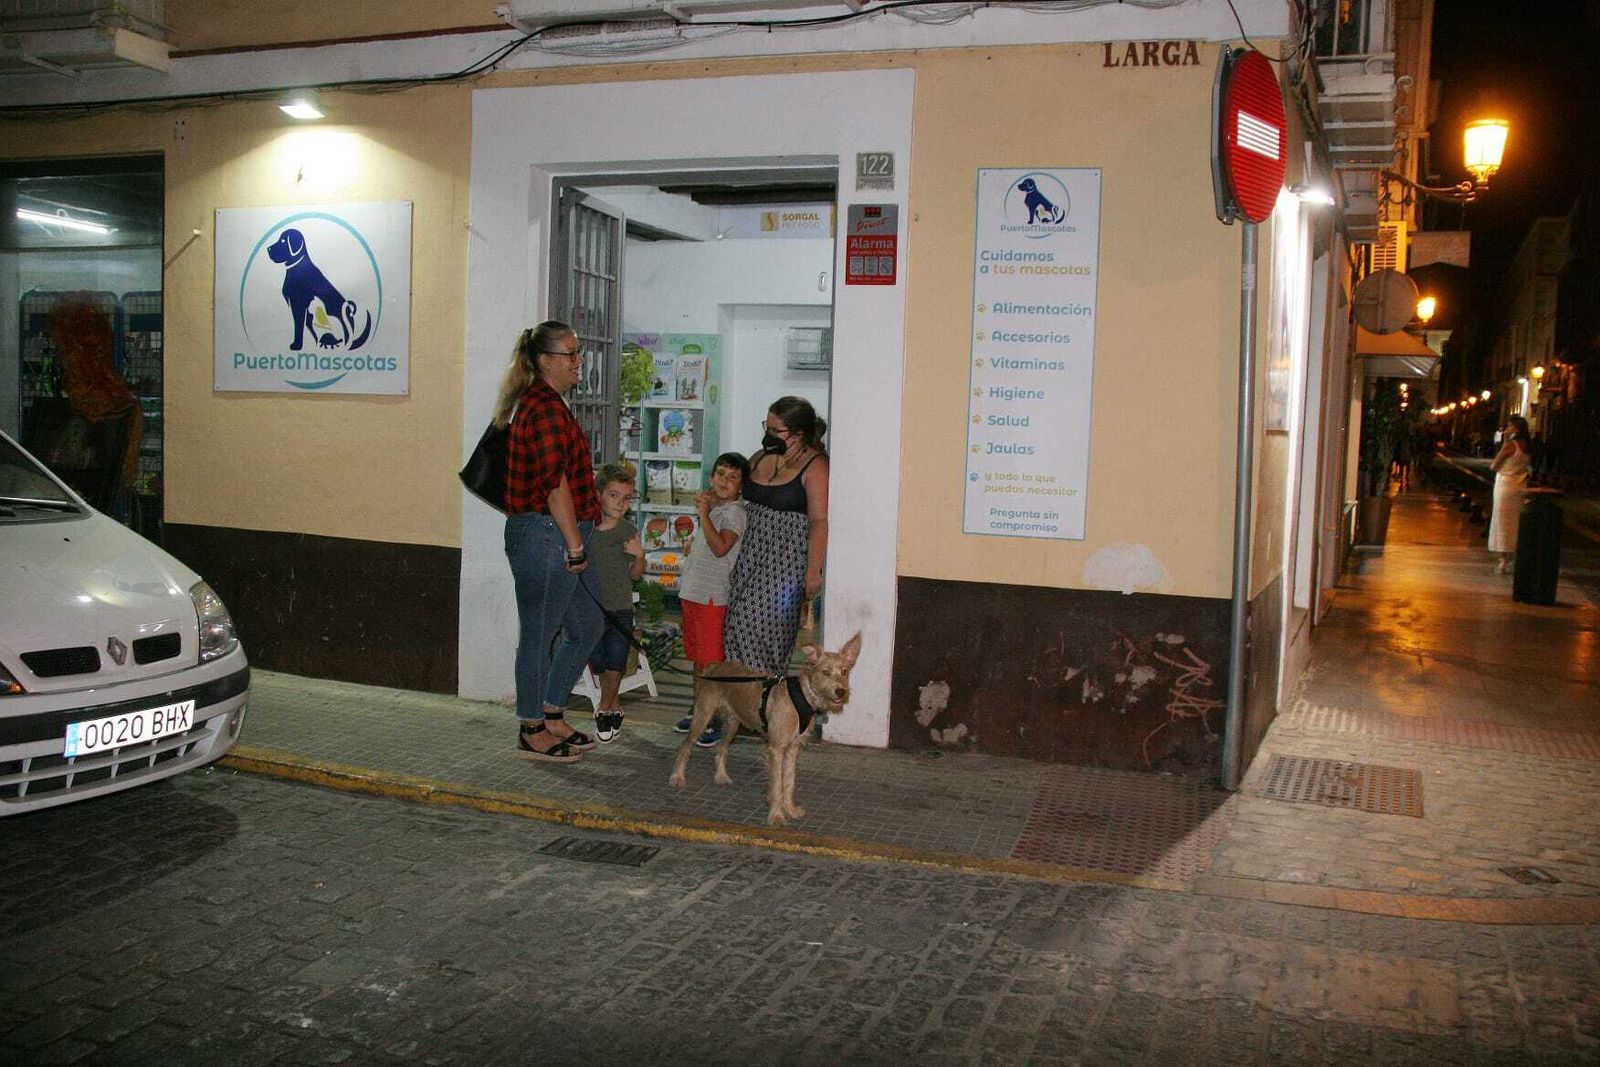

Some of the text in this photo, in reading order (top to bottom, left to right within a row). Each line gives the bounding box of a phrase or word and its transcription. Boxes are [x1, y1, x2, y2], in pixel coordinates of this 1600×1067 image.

[1103, 41, 1200, 67] LARGA
[863, 155, 889, 174] 122
[782, 212, 820, 221] SORGAL
[1000, 224, 1077, 233] PuertoMascotas
[850, 238, 894, 249] Alarma
[980, 250, 1054, 262] Cuidamos
[979, 264, 1091, 276] a tus mascotas
[993, 302, 1092, 316] Alimentación
[991, 331, 1071, 344] Accesorios
[233, 352, 397, 371] PuertoMascotas
[990, 357, 1065, 371] Vitaminas
[989, 386, 1045, 401] Higiene
[987, 414, 1030, 427] Salud
[986, 442, 1034, 455] Jaulas
[984, 471, 1056, 484] y todo lo que
[984, 483, 1078, 497] puedas necesitar
[990, 508, 1059, 520] Pregunta sin
[990, 521, 1058, 532] compromiso
[85, 704, 191, 749] 0020 BHX
